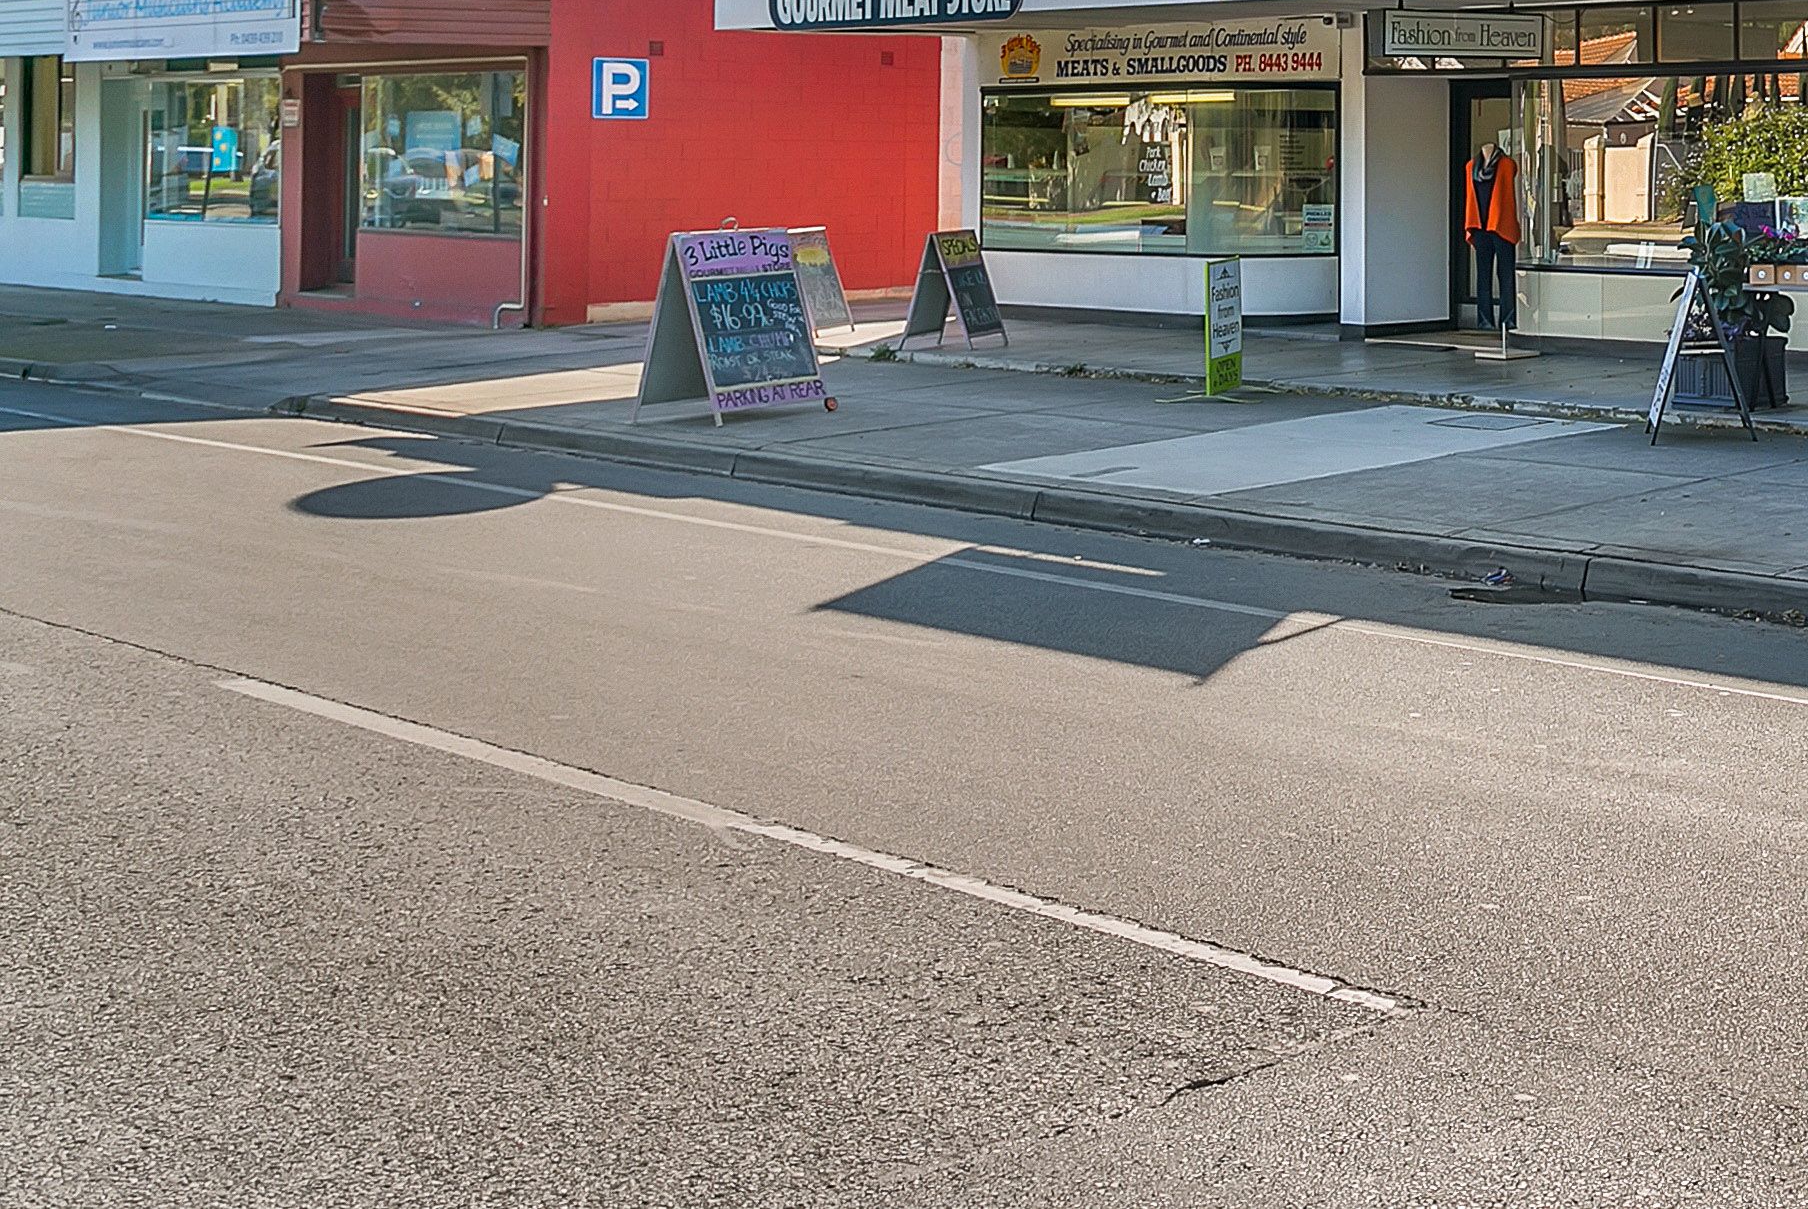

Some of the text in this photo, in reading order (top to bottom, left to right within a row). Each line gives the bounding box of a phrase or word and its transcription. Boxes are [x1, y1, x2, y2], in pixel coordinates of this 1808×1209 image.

[1064, 23, 1307, 57] Specialising in Gourmet and Continental style
[1391, 21, 1536, 48] Fashion from Heaven
[1056, 51, 1322, 78] MEATS & SMALLGOODS PH. 8443 9444
[602, 62, 640, 115] P
[684, 245, 699, 266] 3
[698, 236, 746, 262] Little
[749, 235, 789, 265] Pigs
[941, 236, 977, 256] SPECIALS
[693, 281, 738, 302] LAMB
[1211, 283, 1239, 302] Fashion
[1217, 304, 1235, 319] from
[1212, 320, 1240, 339] Heaven
[717, 379, 827, 409] PARKING AT REAR
